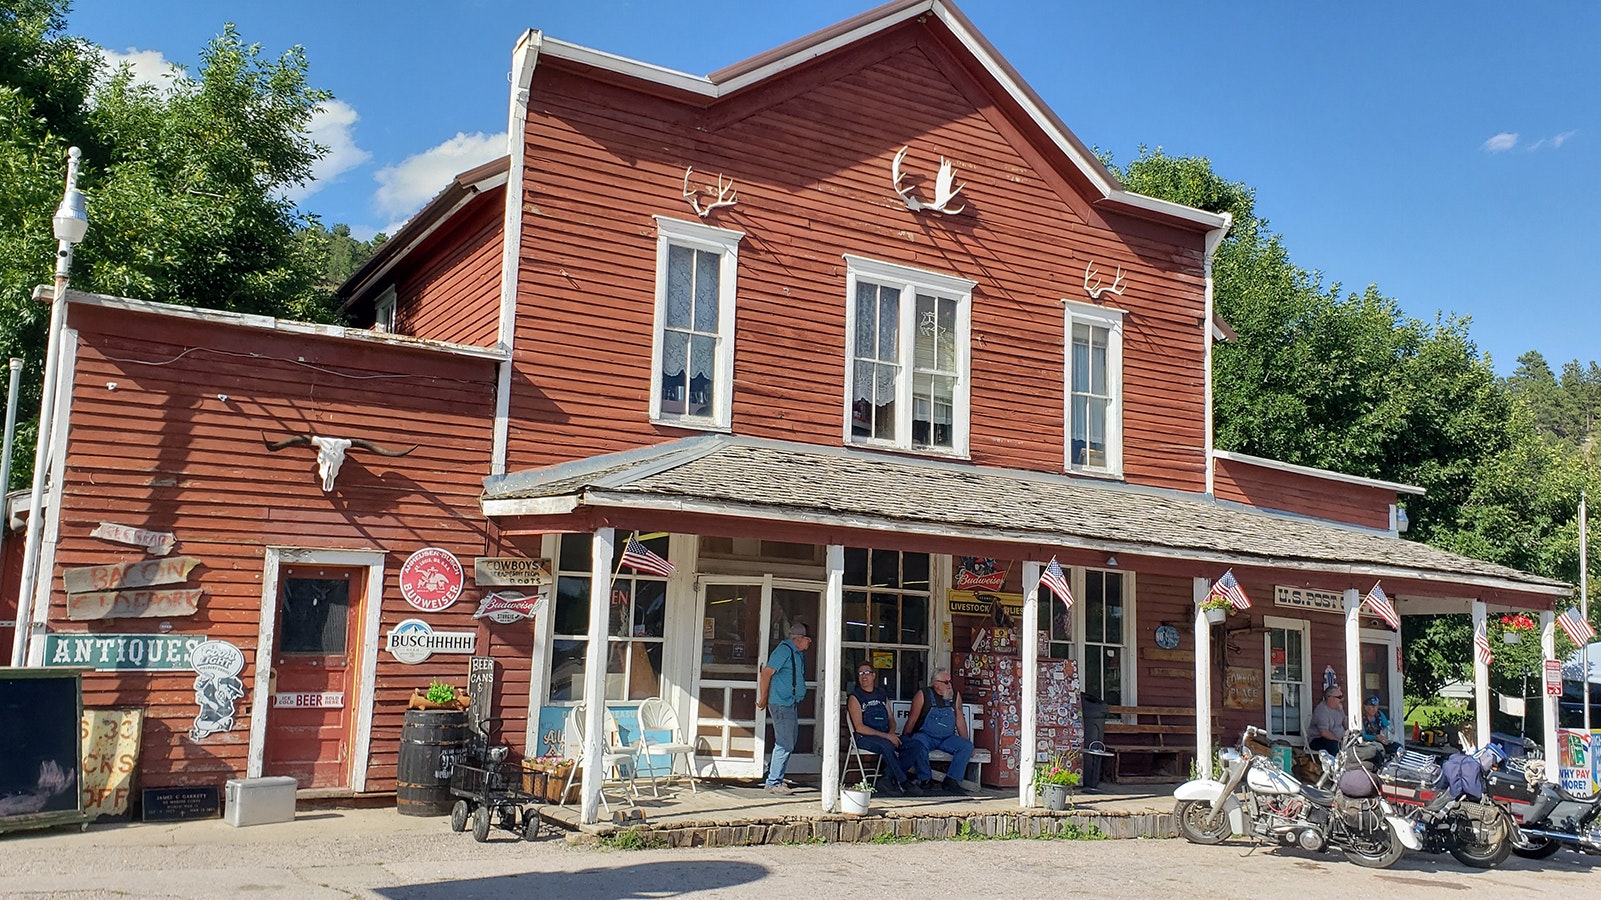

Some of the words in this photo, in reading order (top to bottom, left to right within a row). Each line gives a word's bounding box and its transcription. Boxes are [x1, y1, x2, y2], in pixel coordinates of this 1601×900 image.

[90, 560, 186, 590] BACON
[1278, 588, 1305, 606] U.S.
[1306, 591, 1337, 609] POST
[950, 602, 990, 613] LIVESTOCK
[391, 635, 471, 649] BUSCHHHHH
[52, 638, 200, 666] ANTIQUES
[472, 658, 494, 672] BEER
[470, 672, 494, 684] CANS
[296, 694, 323, 707] BEER
[1575, 769, 1591, 779] PAY
[1561, 780, 1587, 790] MORE?
